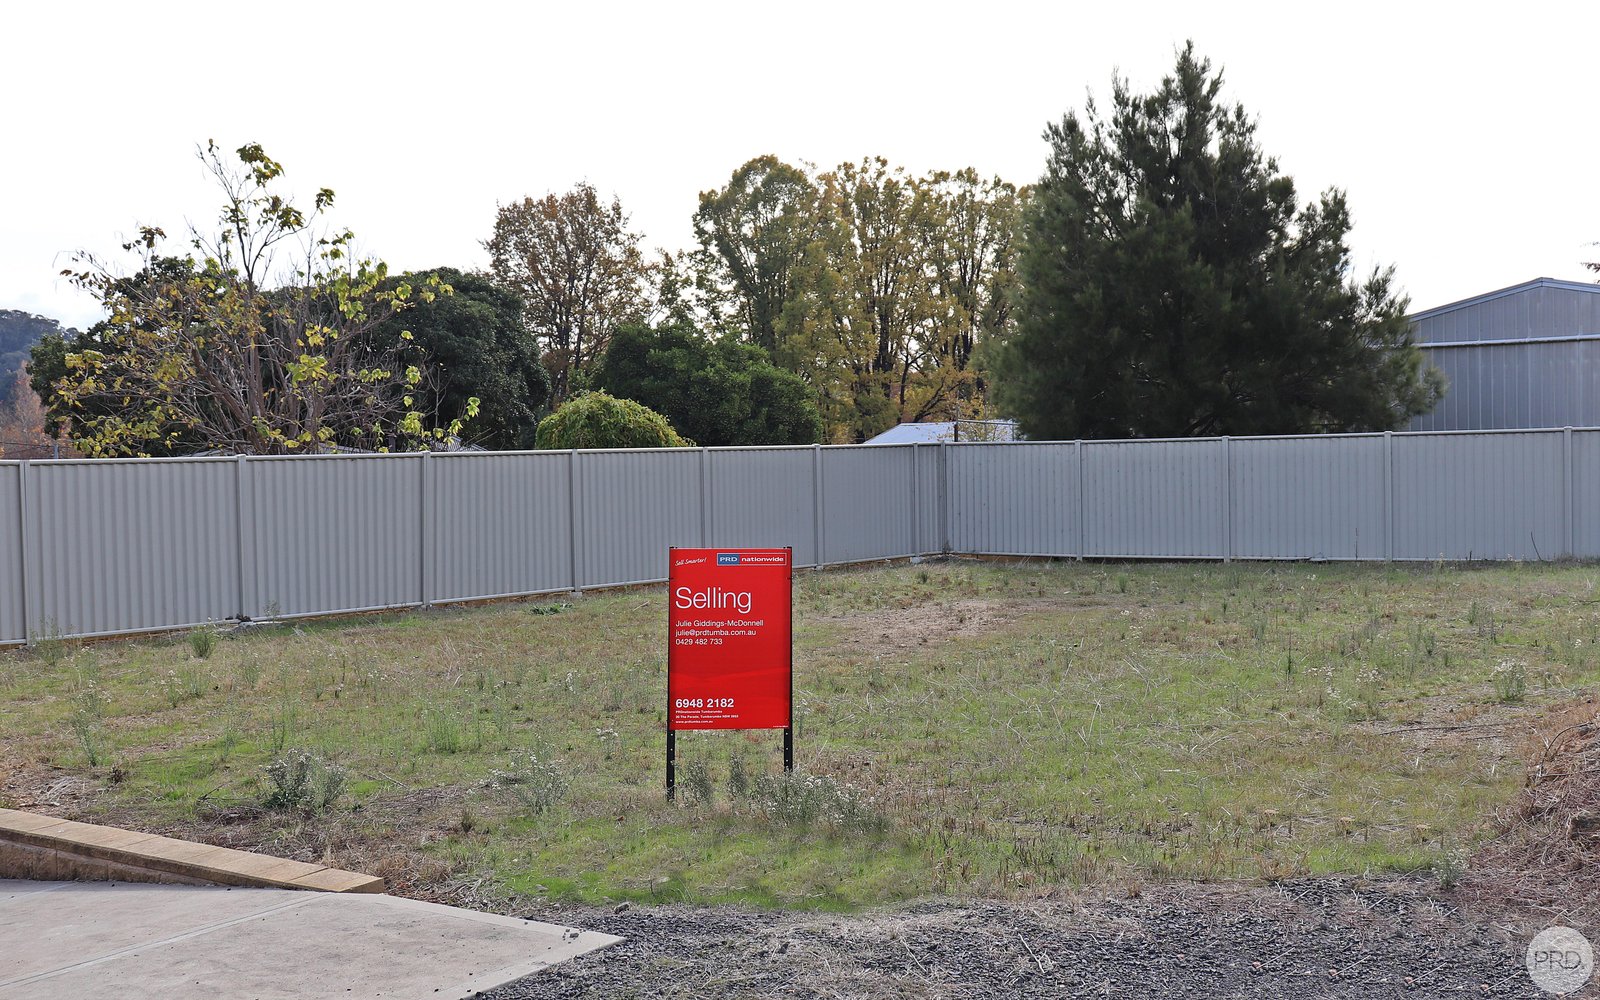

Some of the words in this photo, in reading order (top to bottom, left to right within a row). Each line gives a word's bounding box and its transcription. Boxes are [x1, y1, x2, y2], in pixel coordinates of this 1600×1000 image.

[675, 586, 752, 614] Selling
[693, 619, 764, 628] Giddings-McDonnell
[675, 629, 757, 637] julie@prdtumba.com.au
[675, 698, 703, 708] 6948
[706, 698, 734, 708] 2182
